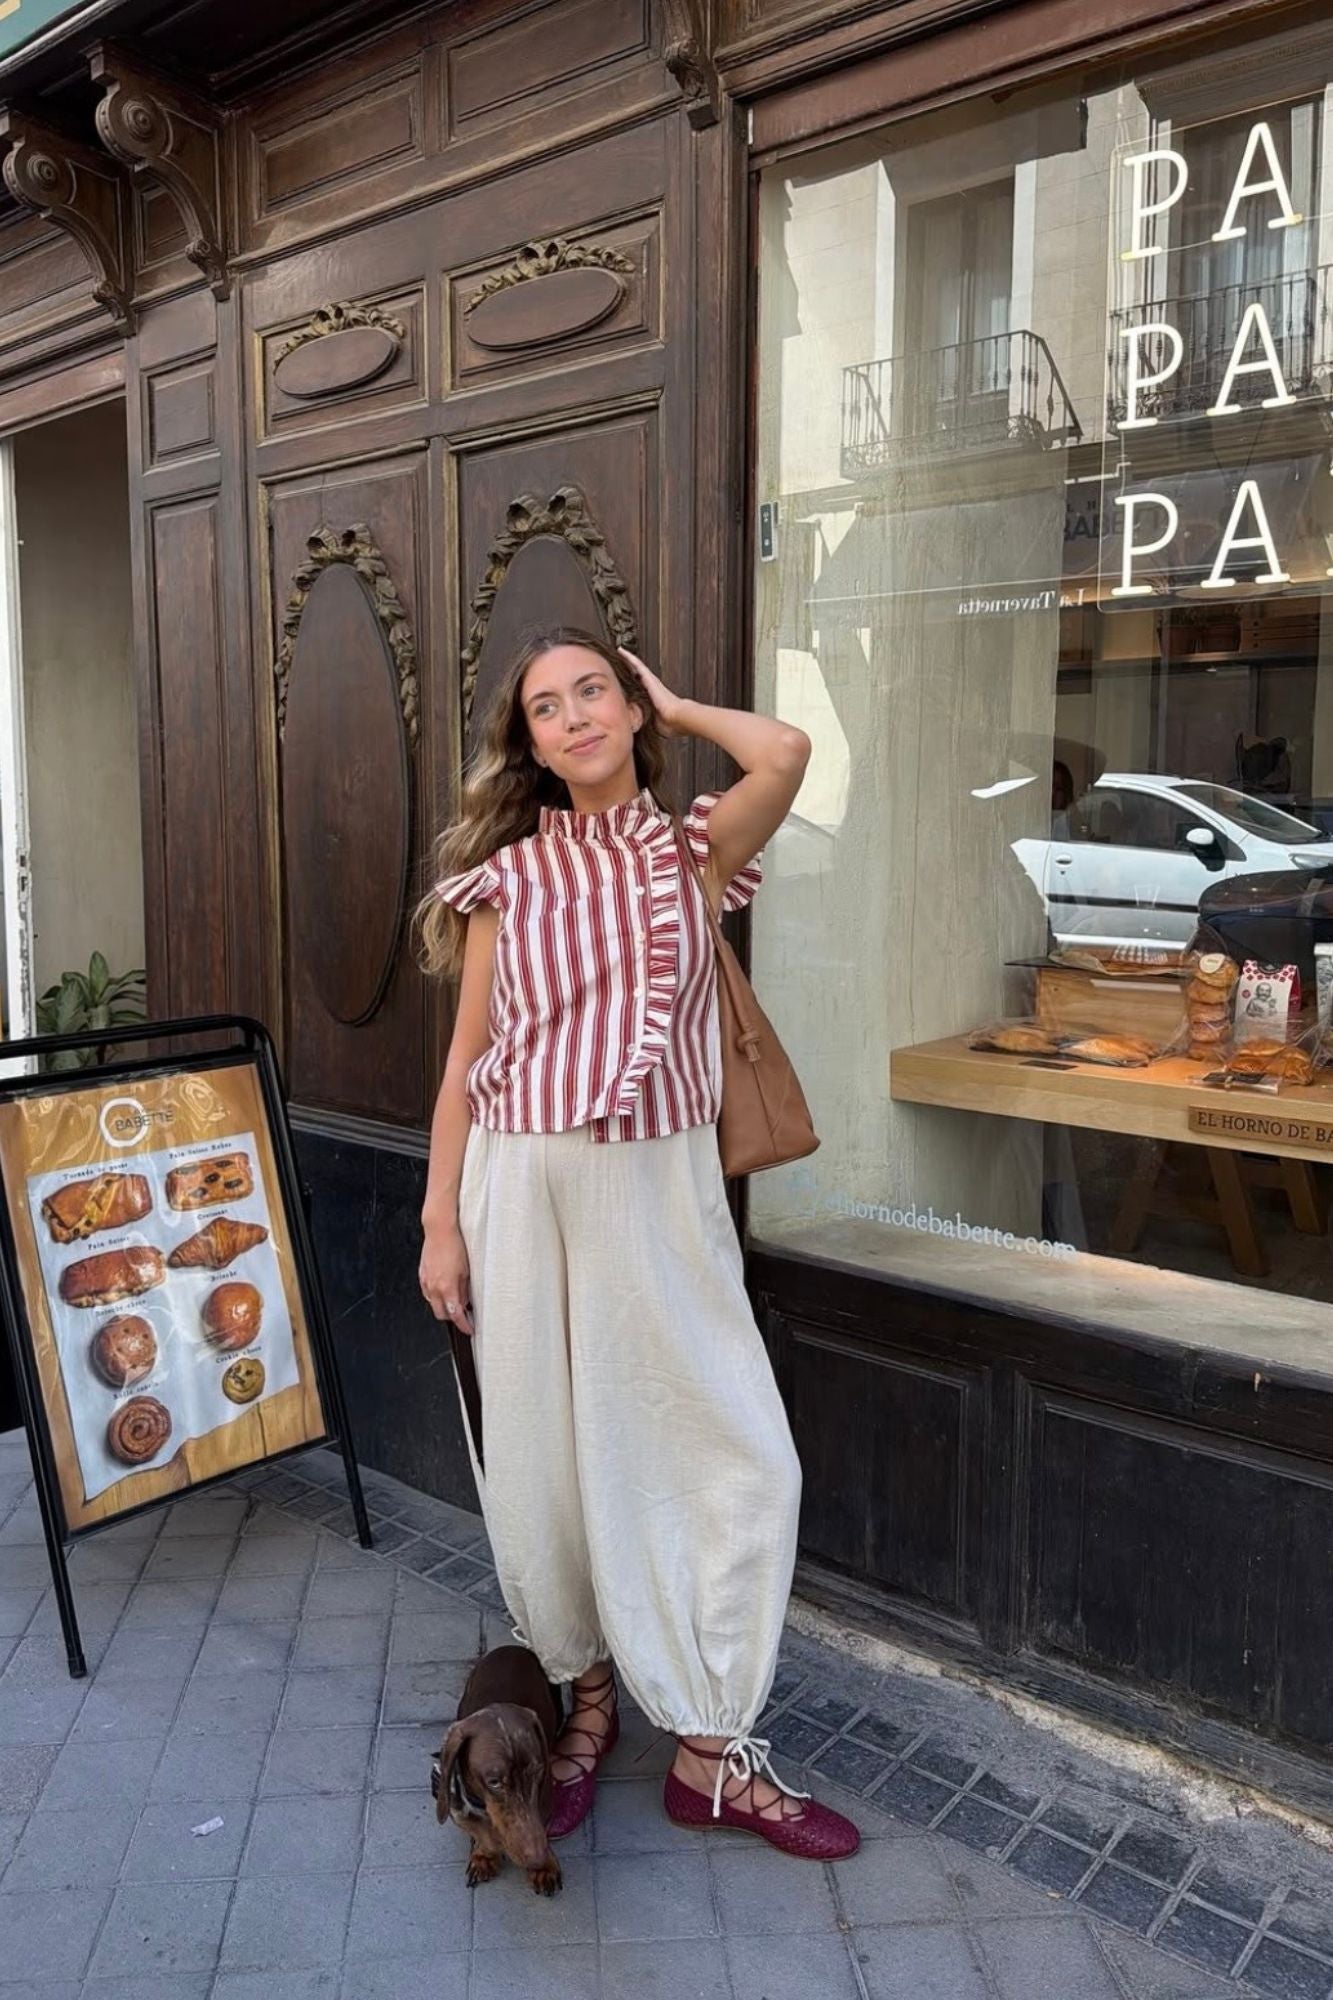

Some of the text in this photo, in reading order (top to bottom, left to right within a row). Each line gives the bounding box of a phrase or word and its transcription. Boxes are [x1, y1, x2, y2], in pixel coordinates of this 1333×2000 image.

[1111, 466, 1333, 596] PA
[115, 1110, 174, 1131] BABETTE
[1198, 1111, 1217, 1127] EL
[1222, 1114, 1283, 1137] HORNO
[1288, 1123, 1310, 1140] DE
